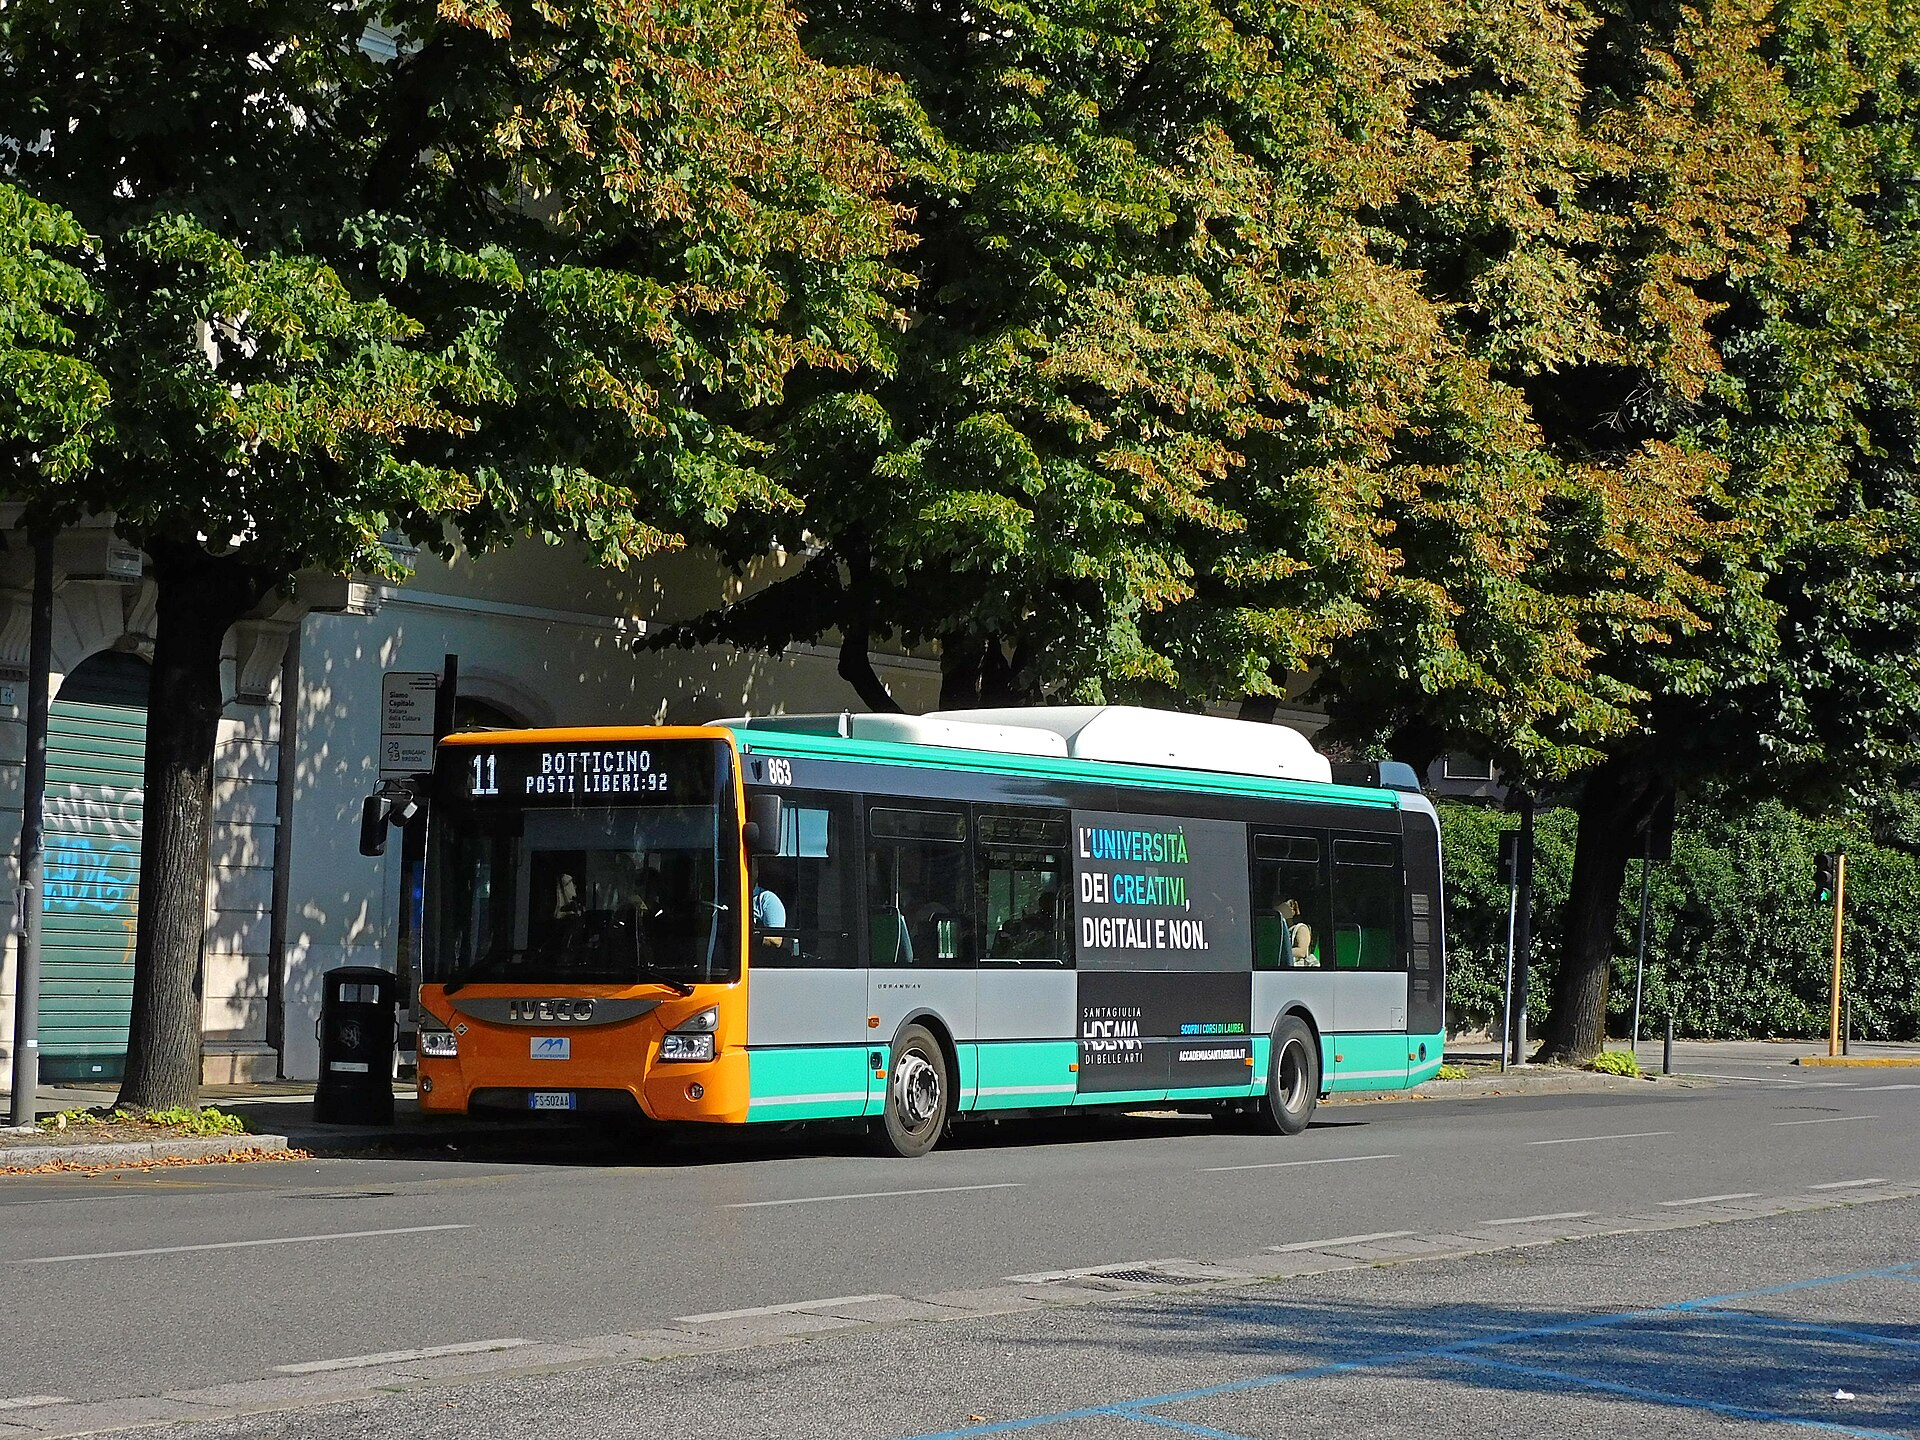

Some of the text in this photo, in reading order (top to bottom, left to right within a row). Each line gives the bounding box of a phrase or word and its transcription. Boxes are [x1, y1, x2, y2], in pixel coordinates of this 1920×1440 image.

[389, 691, 409, 699] Siamo
[542, 751, 651, 774] BOTTICINO
[768, 758, 792, 786] 863
[472, 754, 499, 795] 11
[526, 773, 668, 794] POSTI LIBERI:92
[1079, 825, 1189, 864] L'UNIVERSITÀ
[1081, 872, 1191, 912] DEI CREATIVI,
[1082, 917, 1209, 950] DIGITALI E NON.
[510, 1000, 594, 1021] IVECO
[1084, 1007, 1141, 1017] SANTAGIULIA
[1181, 1024, 1199, 1034] SCOPRI
[1203, 1023, 1217, 1034] CORSI
[1218, 1023, 1224, 1033] DI
[1225, 1023, 1244, 1033] LAUREA
[1085, 1052, 1143, 1065] DI BELLE ARTI
